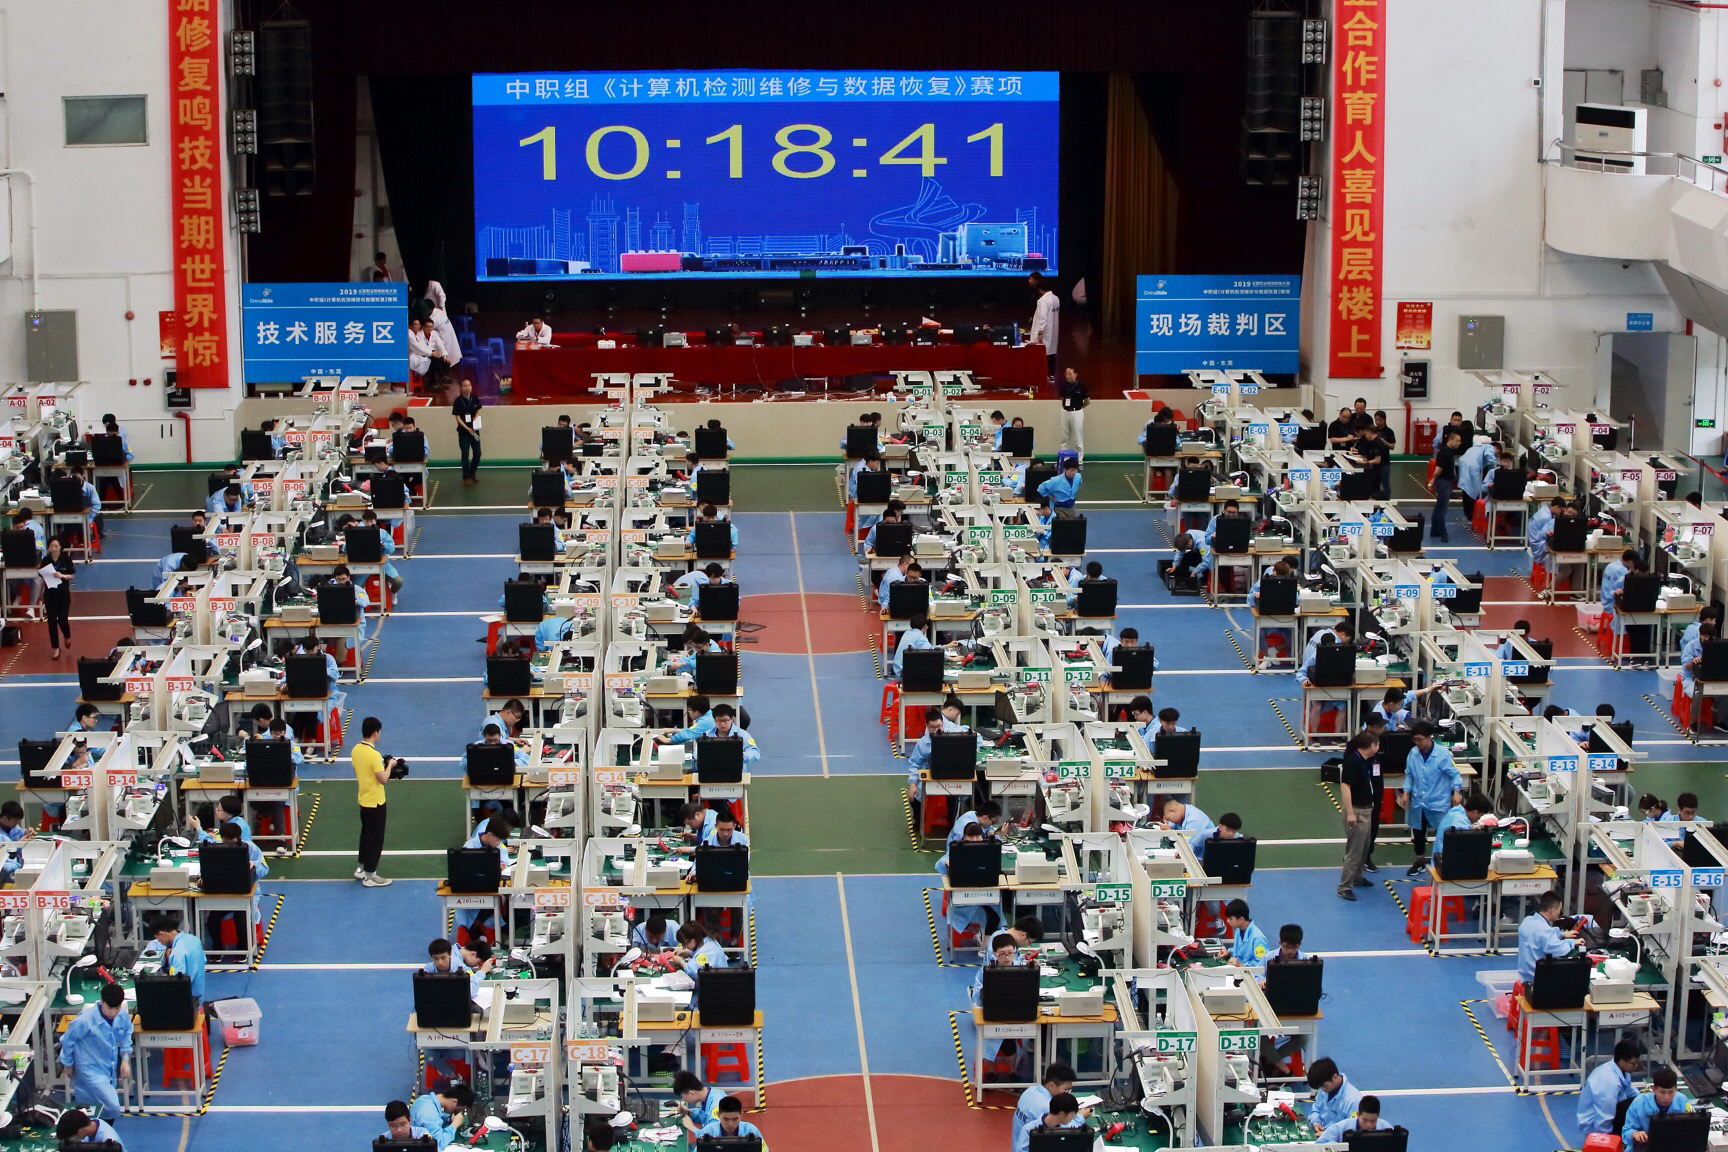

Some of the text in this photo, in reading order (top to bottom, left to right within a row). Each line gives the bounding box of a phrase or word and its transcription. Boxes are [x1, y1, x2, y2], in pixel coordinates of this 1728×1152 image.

[506, 76, 1022, 100] 中职组《计算机检测维修与数据恢复》赛项
[518, 123, 1004, 180] 10:18:41
[1337, 0, 1379, 358] 合作育人喜见层楼上
[1150, 312, 1287, 336] 现场裁判区
[256, 321, 395, 345] 技术服务区
[313, 394, 330, 402] B-01
[341, 392, 358, 400] B-02
[9, 399, 27, 407] A-01
[605, 431, 622, 439] C-03
[635, 431, 652, 439] C-04
[924, 428, 943, 436] D-03
[961, 428, 979, 436] D-04
[1280, 426, 1297, 434] E-04
[287, 434, 305, 442] B-03
[312, 433, 331, 441] B-04
[0, 440, 12, 448] -04
[947, 475, 967, 483] D-05
[979, 475, 1000, 483] D-06
[1290, 472, 1309, 480] E-05
[1321, 472, 1340, 480] E-06
[1622, 472, 1640, 480] F-05
[1656, 472, 1674, 480] F-06
[253, 482, 273, 491] B-05
[284, 482, 304, 491] B-06
[597, 479, 616, 487] C-05
[628, 479, 647, 487] C-06
[969, 530, 991, 538] D-07
[1004, 530, 1025, 538] D-08
[1341, 526, 1362, 535] E-07
[1372, 527, 1393, 535] E-08
[1694, 526, 1712, 534] F-07
[218, 537, 240, 546] B-07
[252, 535, 274, 546] B-08
[588, 533, 609, 542] C-07
[622, 533, 643, 542] C-08
[1032, 593, 1054, 602] D-10
[1396, 589, 1418, 598] E-09
[1433, 588, 1455, 597] E-10
[577, 598, 599, 607] C-09
[613, 598, 637, 607] C-10
[993, 594, 1015, 602] D-09
[172, 601, 195, 611] B-09
[211, 600, 235, 611] B-10
[1465, 666, 1490, 676] E-11
[1503, 665, 1527, 675] E-12
[1024, 672, 1050, 682] D-11
[1065, 671, 1091, 681] D-12
[127, 681, 153, 692] B-11
[167, 681, 192, 691] B-12
[565, 678, 590, 688] C-11
[606, 678, 632, 688] C-12
[1550, 760, 1576, 771] E-13
[1589, 758, 1615, 770] E-14
[1060, 766, 1089, 777] D-13
[1105, 766, 1134, 777] D-14
[62, 775, 92, 786] B-13
[107, 774, 136, 786] B-14
[550, 773, 578, 783] C-13
[596, 772, 624, 783] C-14
[1652, 875, 1681, 887] E-15
[1693, 874, 1722, 886] E-16
[1098, 889, 1130, 901] D-15
[1153, 885, 1185, 897] D-16
[0, 897, 28, 908] B-15
[37, 897, 68, 908] B-16
[536, 894, 568, 906] C-15
[585, 894, 617, 905] C-16
[1158, 1038, 1195, 1051] D-17
[1221, 1036, 1257, 1049] D-18
[513, 1048, 549, 1062] C-17
[570, 1047, 605, 1060] C-18
